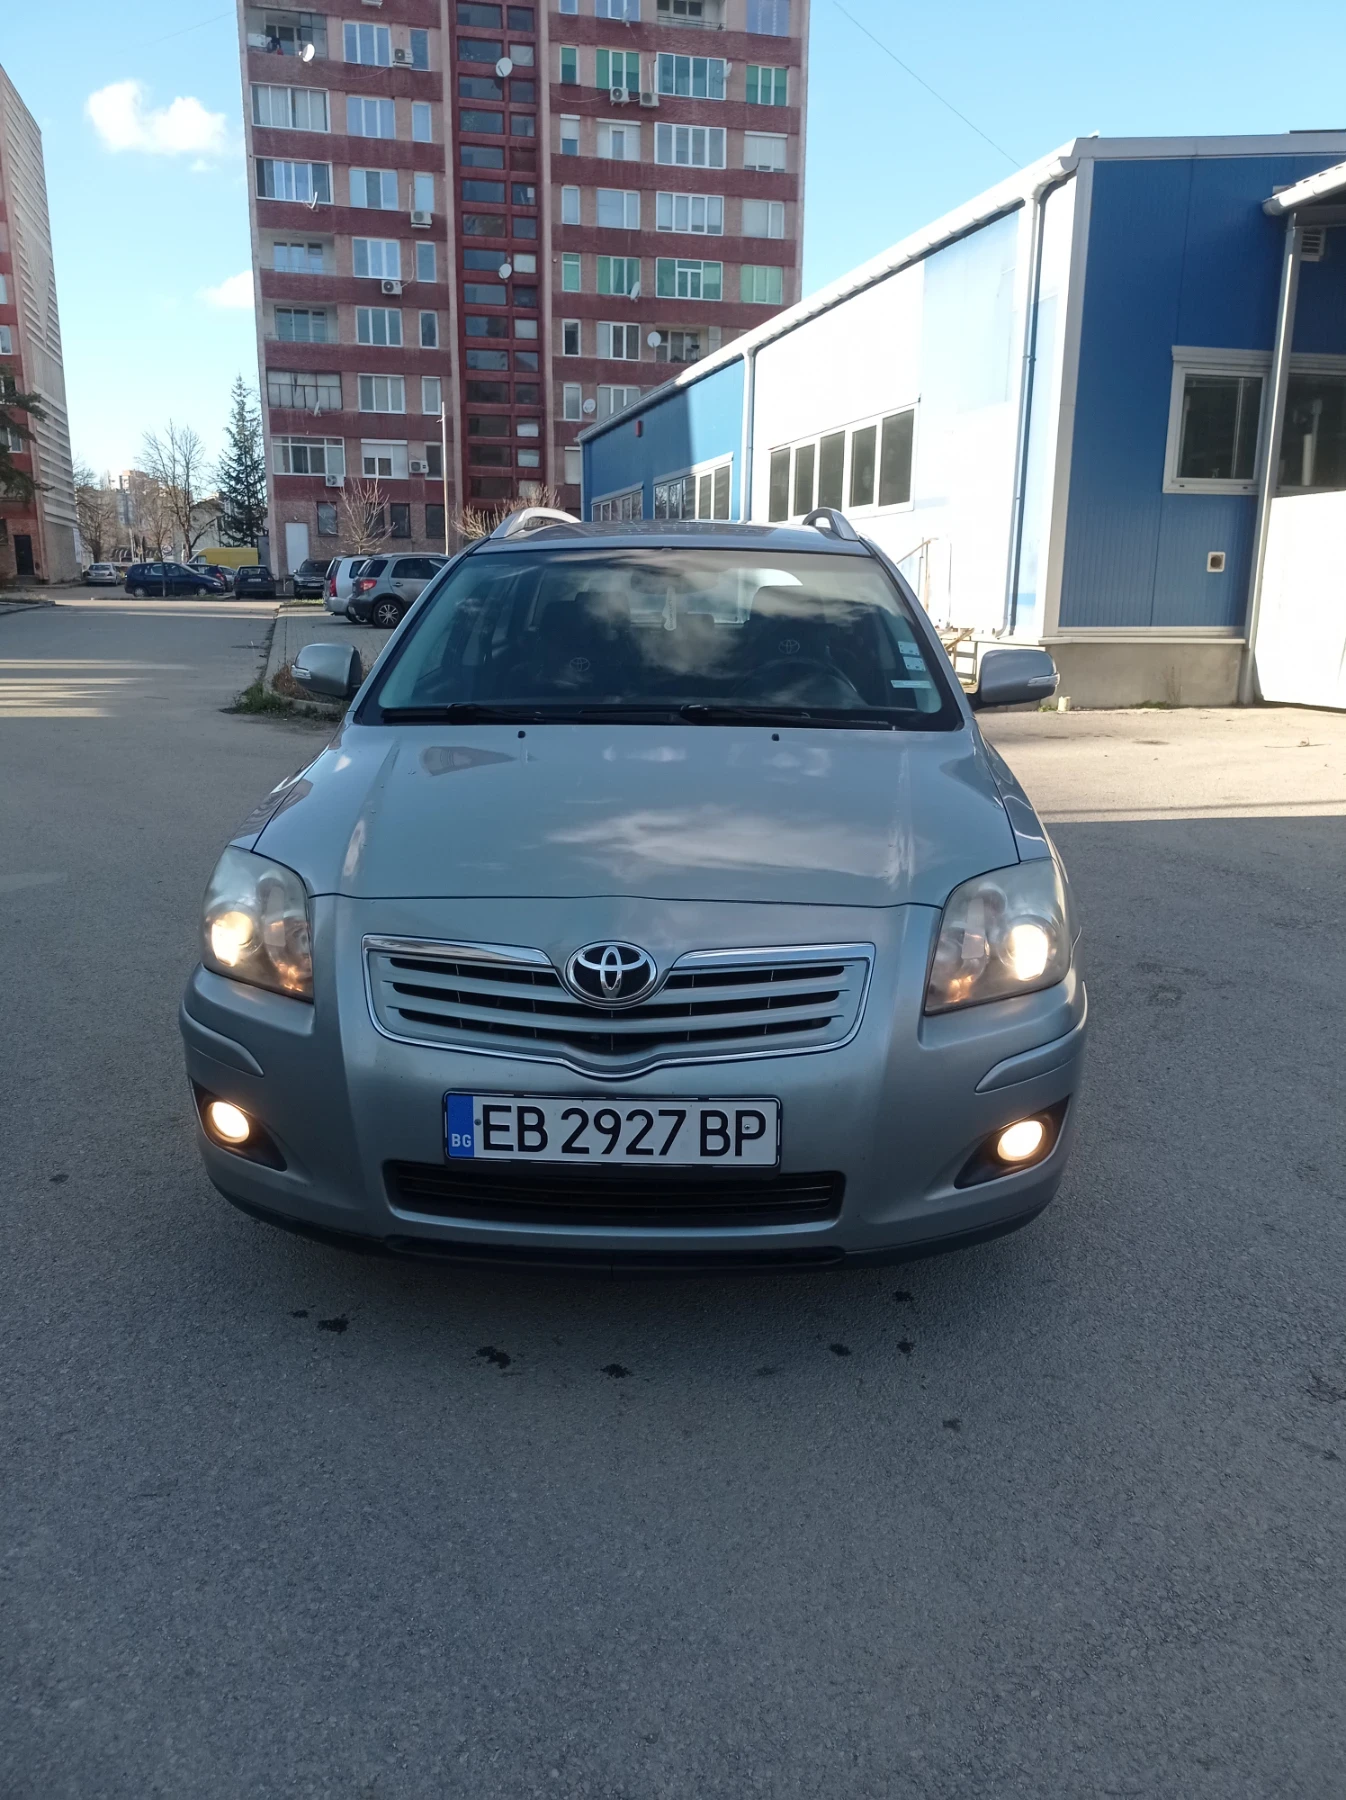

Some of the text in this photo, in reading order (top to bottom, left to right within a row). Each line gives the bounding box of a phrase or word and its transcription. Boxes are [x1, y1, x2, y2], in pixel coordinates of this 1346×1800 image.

[451, 1133, 472, 1148] BG
[482, 1104, 766, 1157] EB 2927 BP
